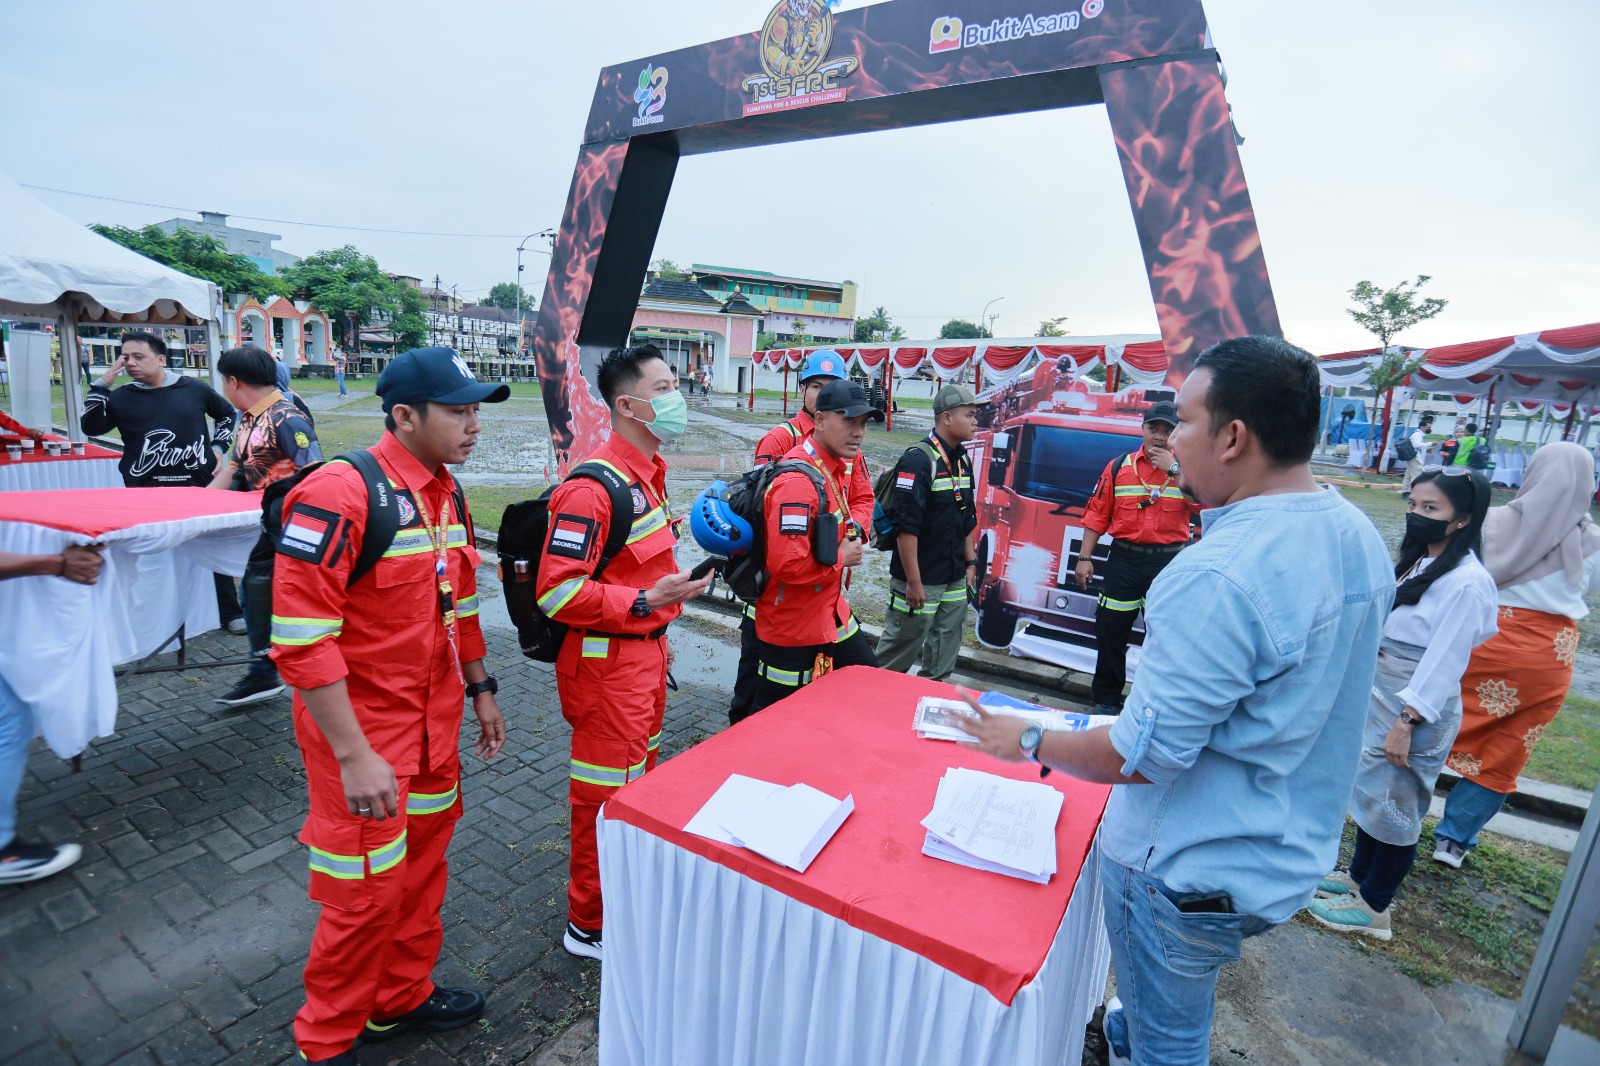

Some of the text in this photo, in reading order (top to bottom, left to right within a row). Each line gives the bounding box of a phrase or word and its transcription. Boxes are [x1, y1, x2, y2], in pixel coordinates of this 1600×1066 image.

[775, 69, 839, 99] SFRC
[747, 104, 772, 113] SUMATERA
[791, 98, 810, 106] RESCUE
[811, 92, 842, 102] CHALLENGE
[603, 470, 620, 488] torch
[376, 483, 388, 507] torch
[552, 540, 582, 551] INDONESIA
